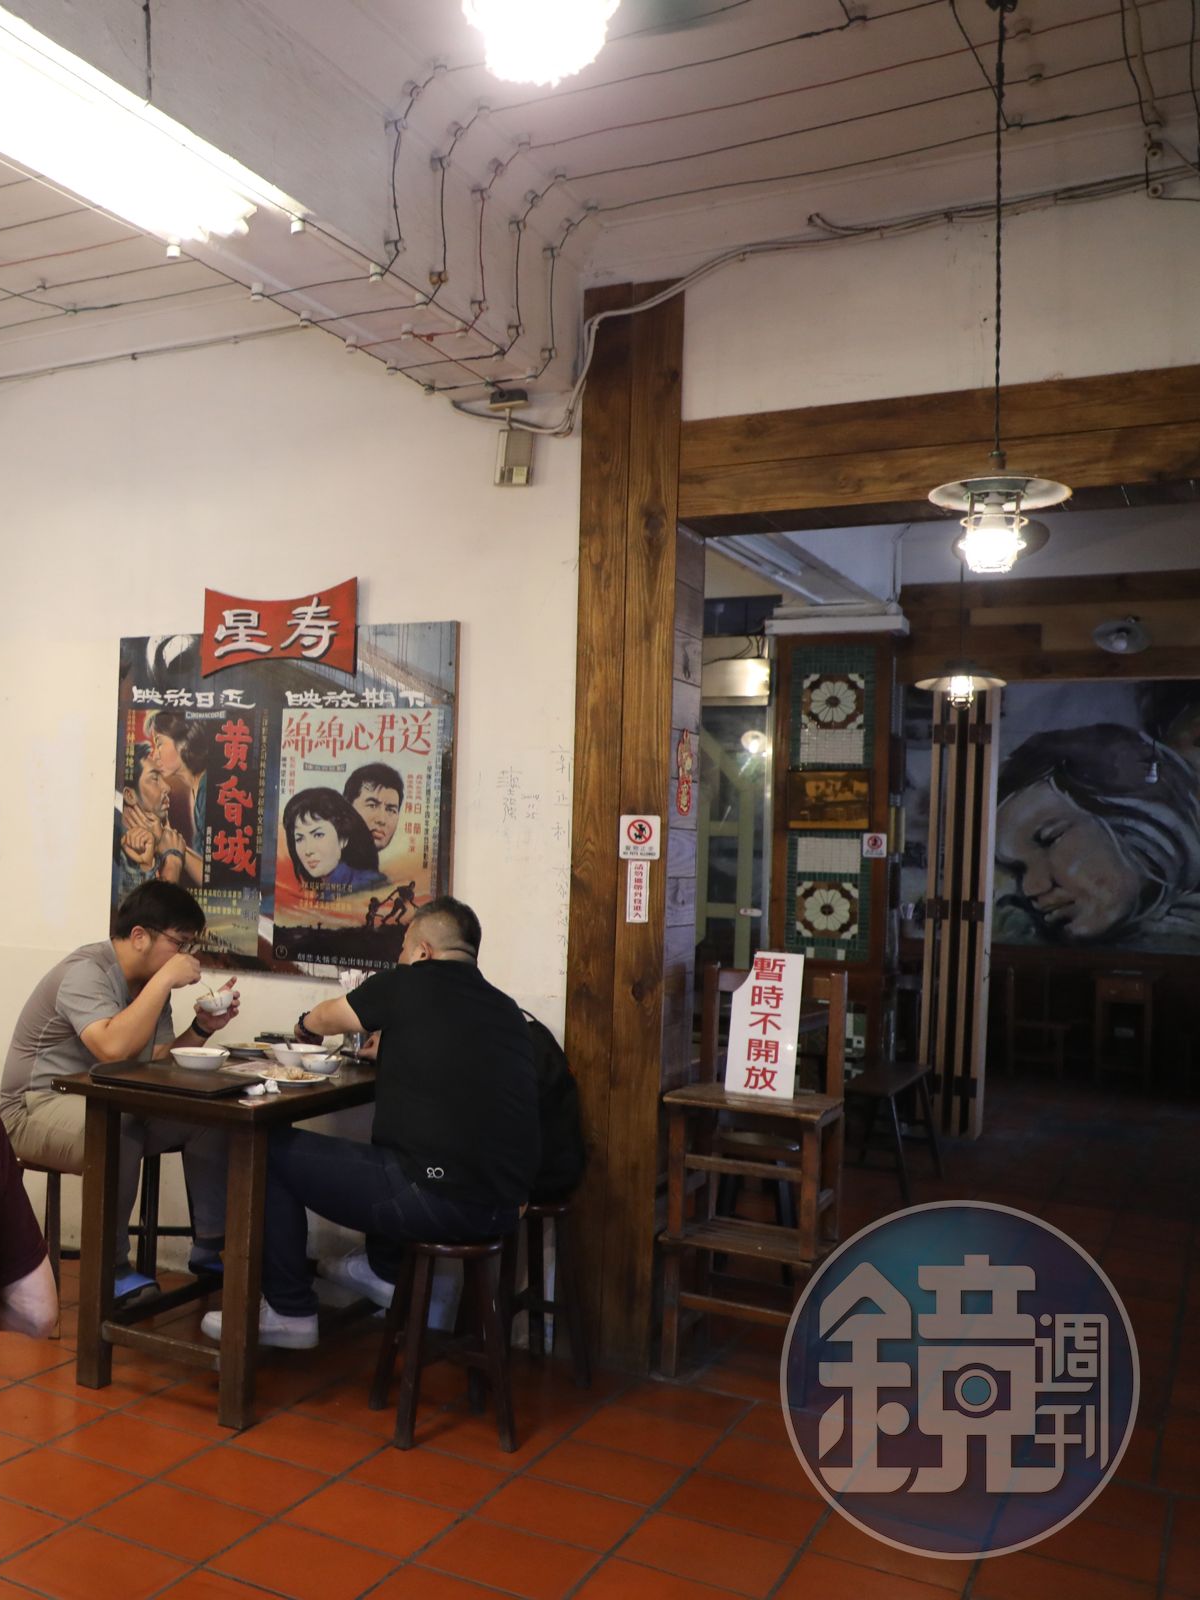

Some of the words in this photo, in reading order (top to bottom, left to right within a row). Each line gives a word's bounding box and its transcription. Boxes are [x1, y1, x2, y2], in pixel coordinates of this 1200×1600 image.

[743, 957, 786, 1091] 暫時不開放
